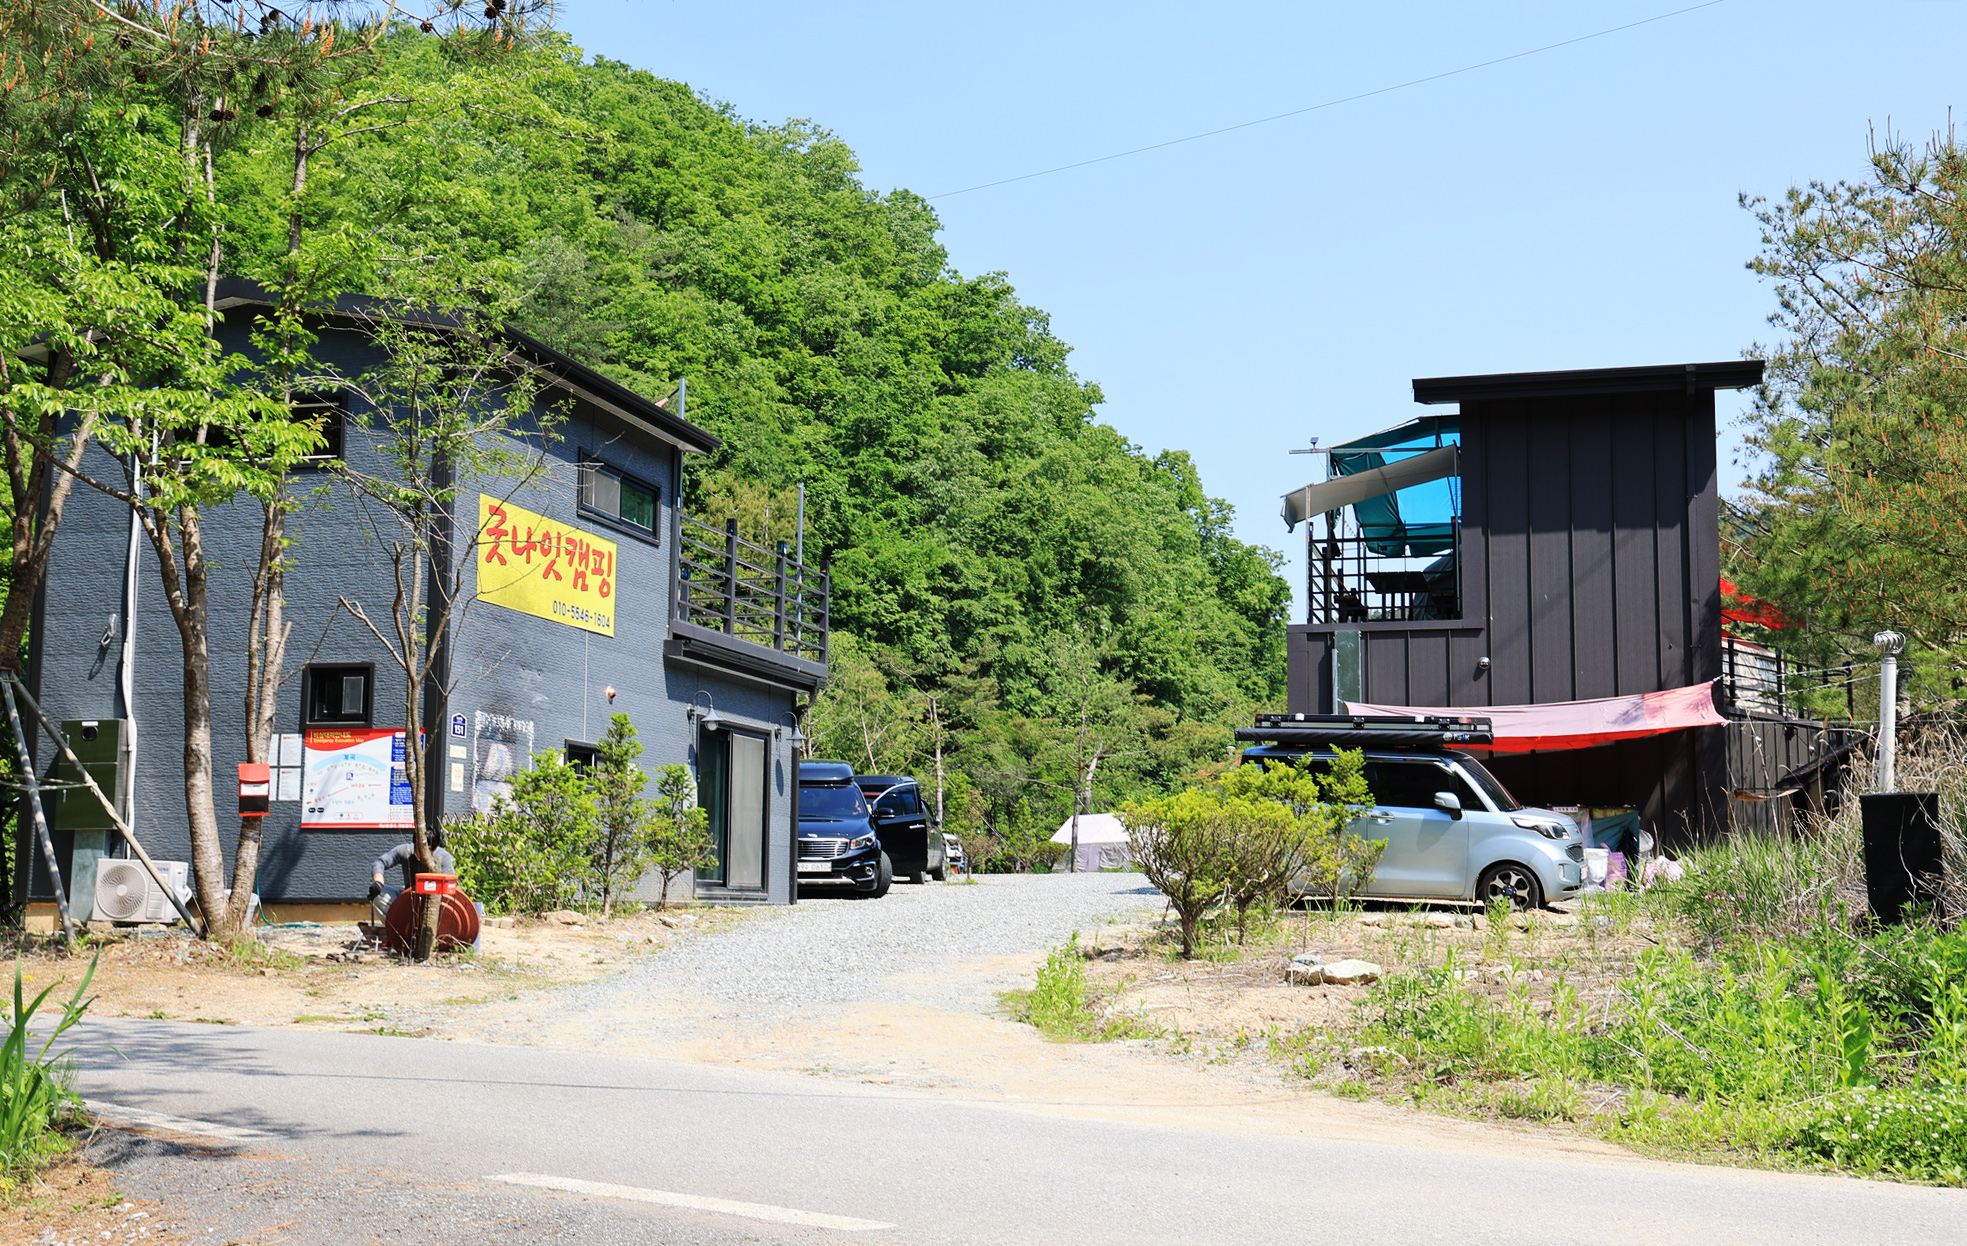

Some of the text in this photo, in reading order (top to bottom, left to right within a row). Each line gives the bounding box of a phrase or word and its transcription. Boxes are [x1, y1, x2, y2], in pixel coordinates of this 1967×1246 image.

[485, 504, 613, 598] 굿나잇캠핑
[553, 600, 610, 629] 010-5546-1604
[454, 724, 464, 735] 151
